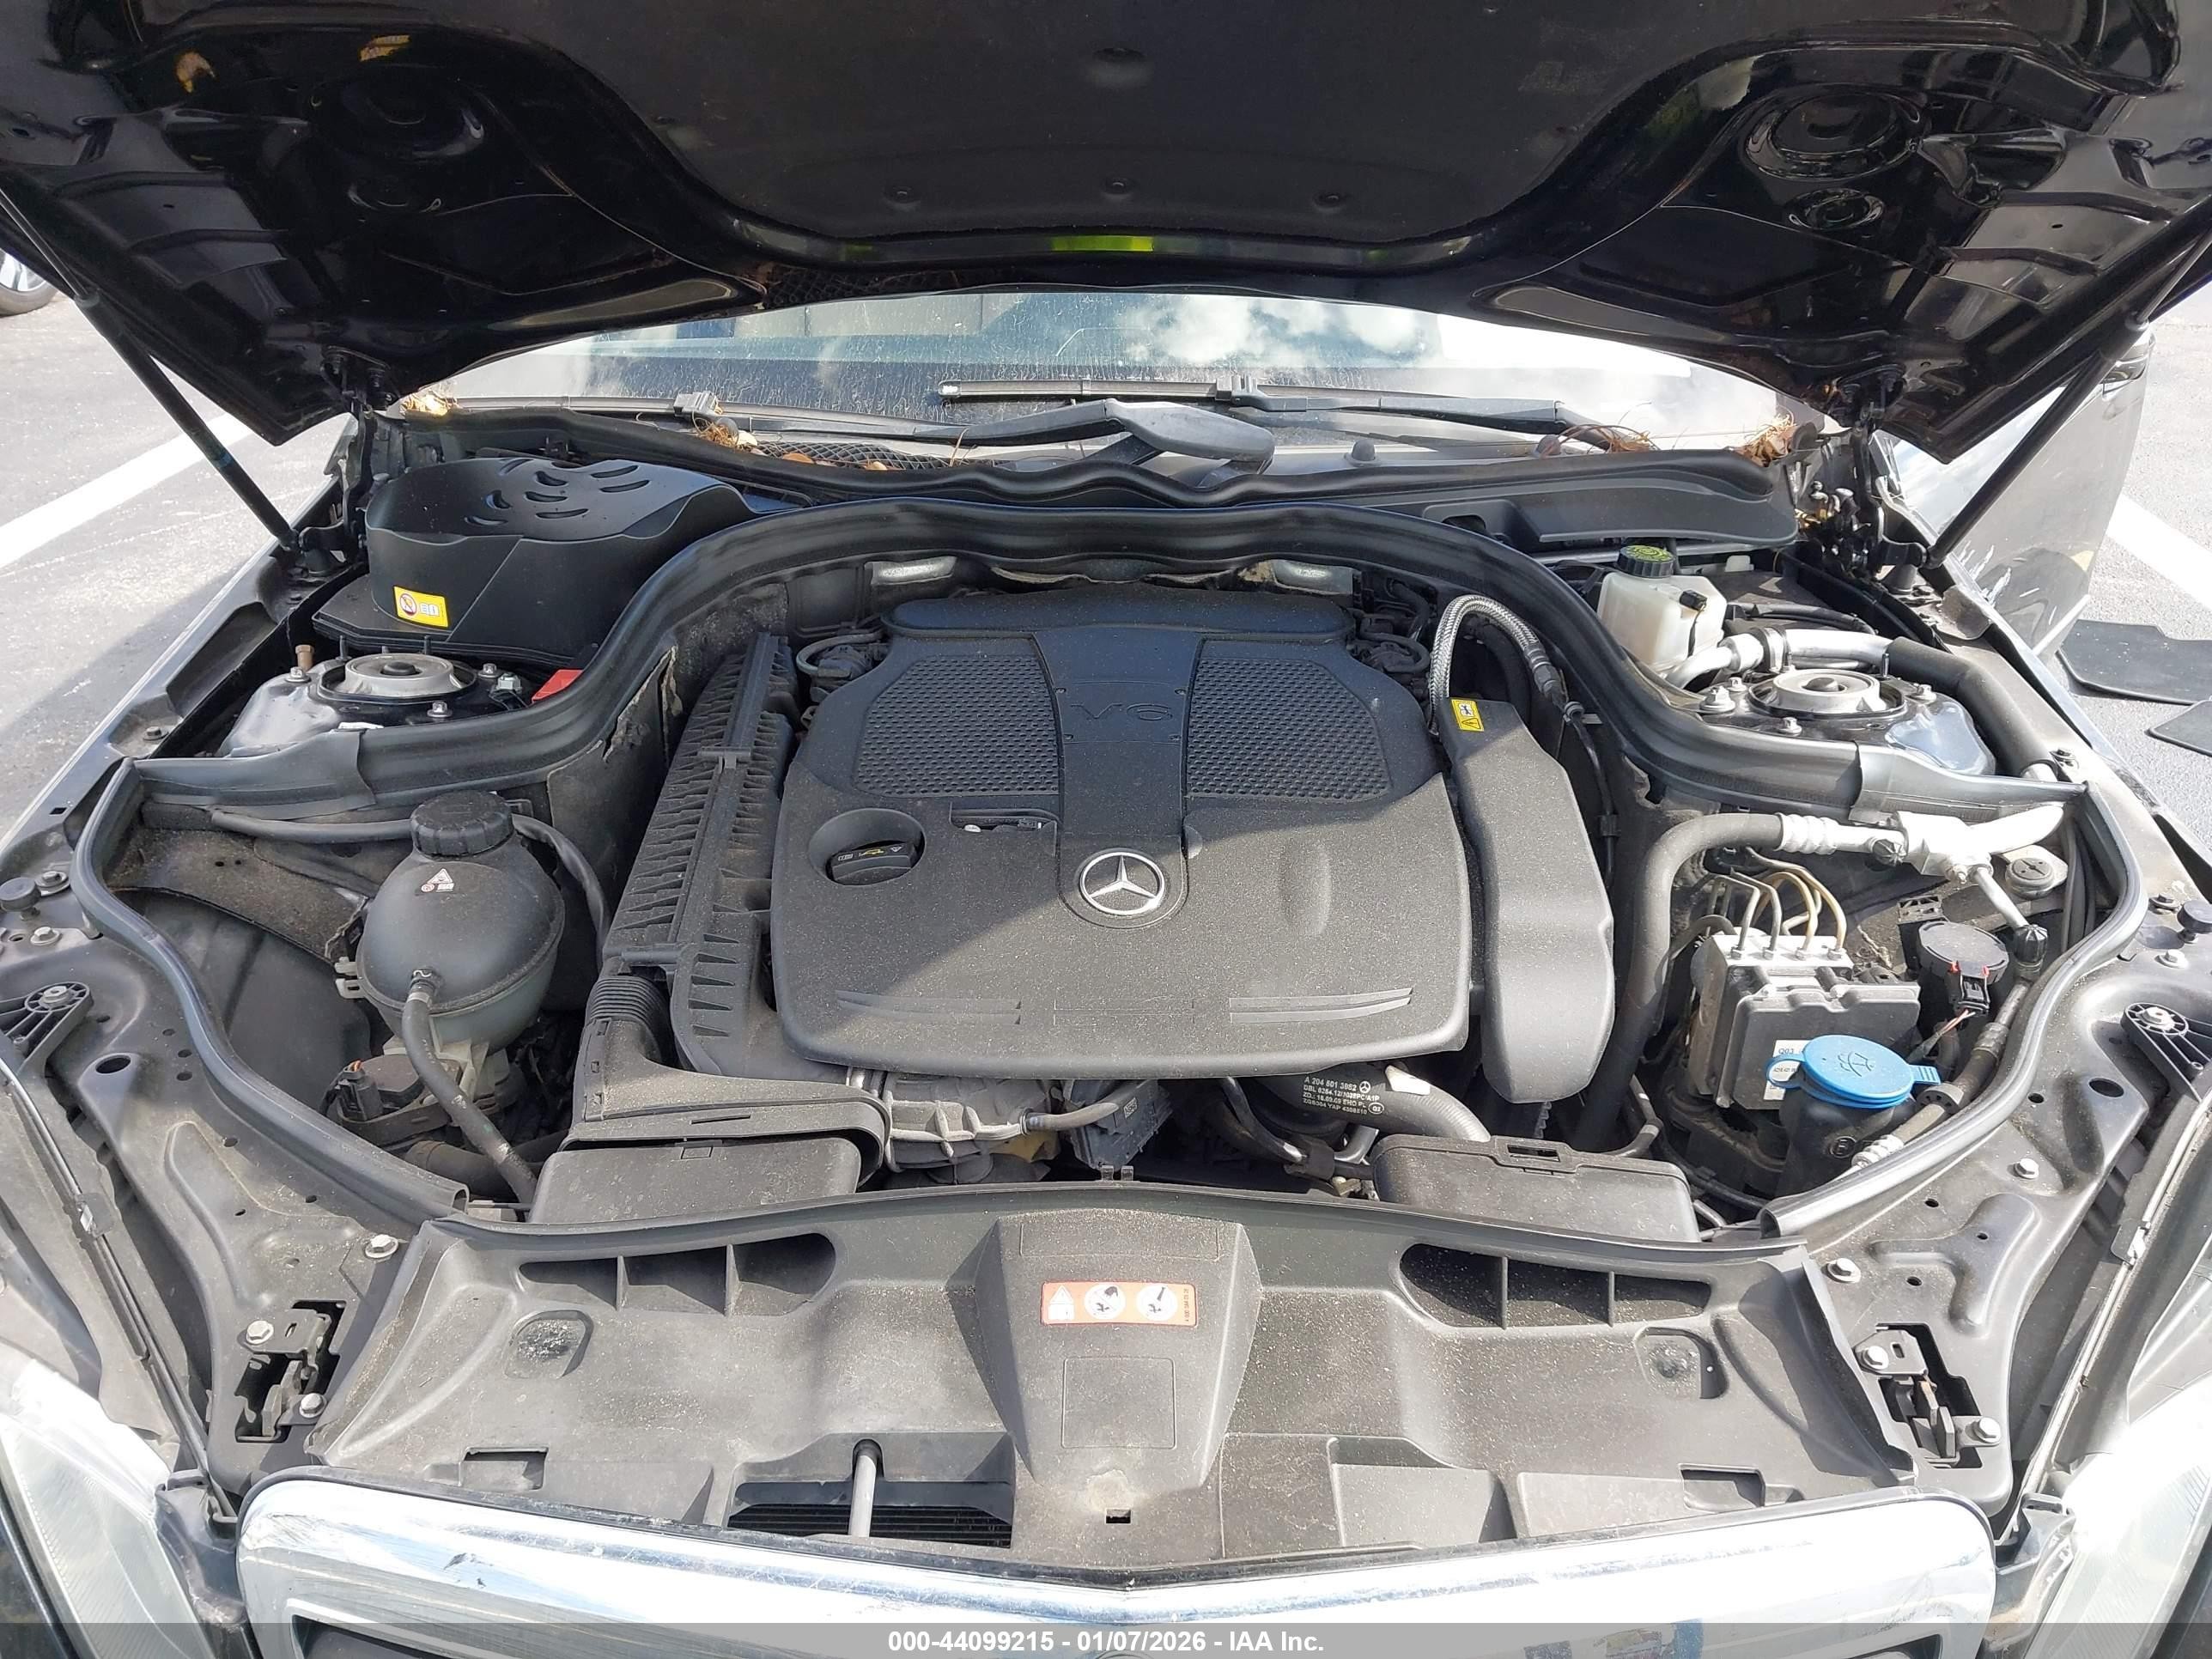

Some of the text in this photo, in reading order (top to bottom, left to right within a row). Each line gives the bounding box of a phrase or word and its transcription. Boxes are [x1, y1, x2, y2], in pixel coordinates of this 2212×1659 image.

[1070, 702, 1174, 721] V6
[1304, 1076, 1310, 1085] A
[1312, 1077, 1325, 1086] 204
